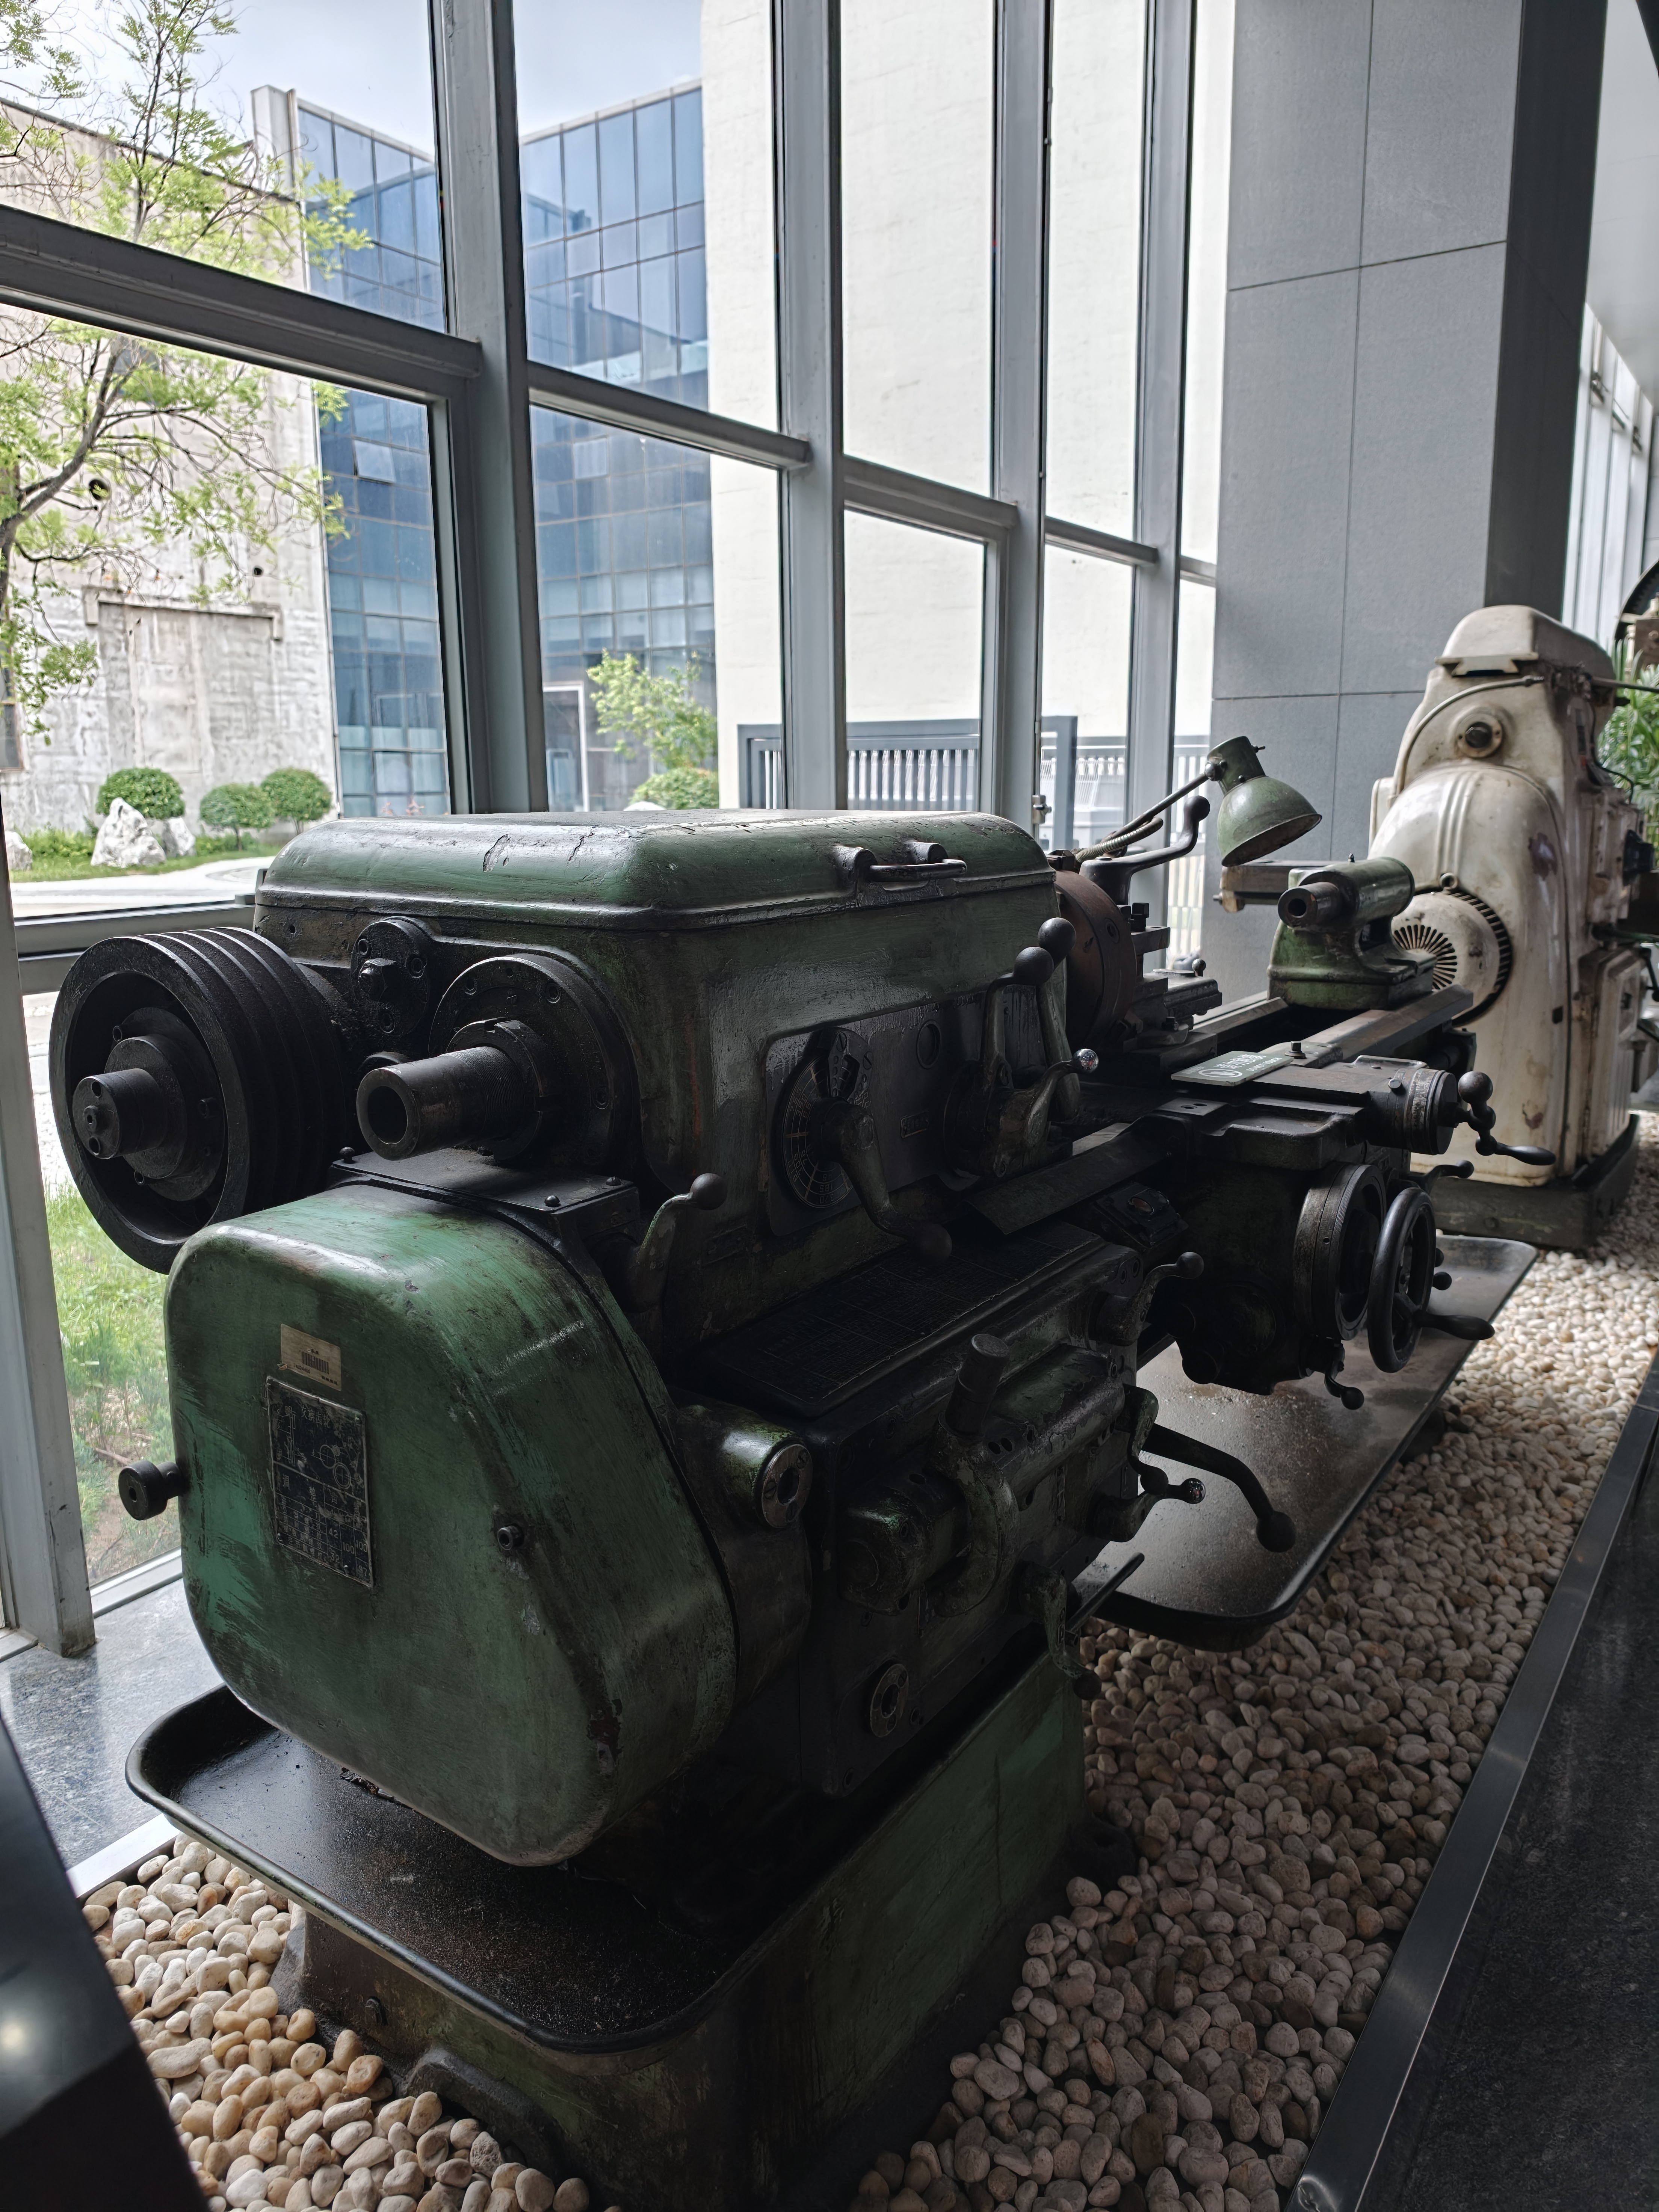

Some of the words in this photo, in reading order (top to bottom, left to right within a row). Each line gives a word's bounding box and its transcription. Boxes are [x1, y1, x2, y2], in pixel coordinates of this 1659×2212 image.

[329, 1528, 338, 1539] 42
[343, 1542, 355, 1554] 100
[357, 1540, 368, 1553] 100
[331, 1552, 340, 1564] 32
